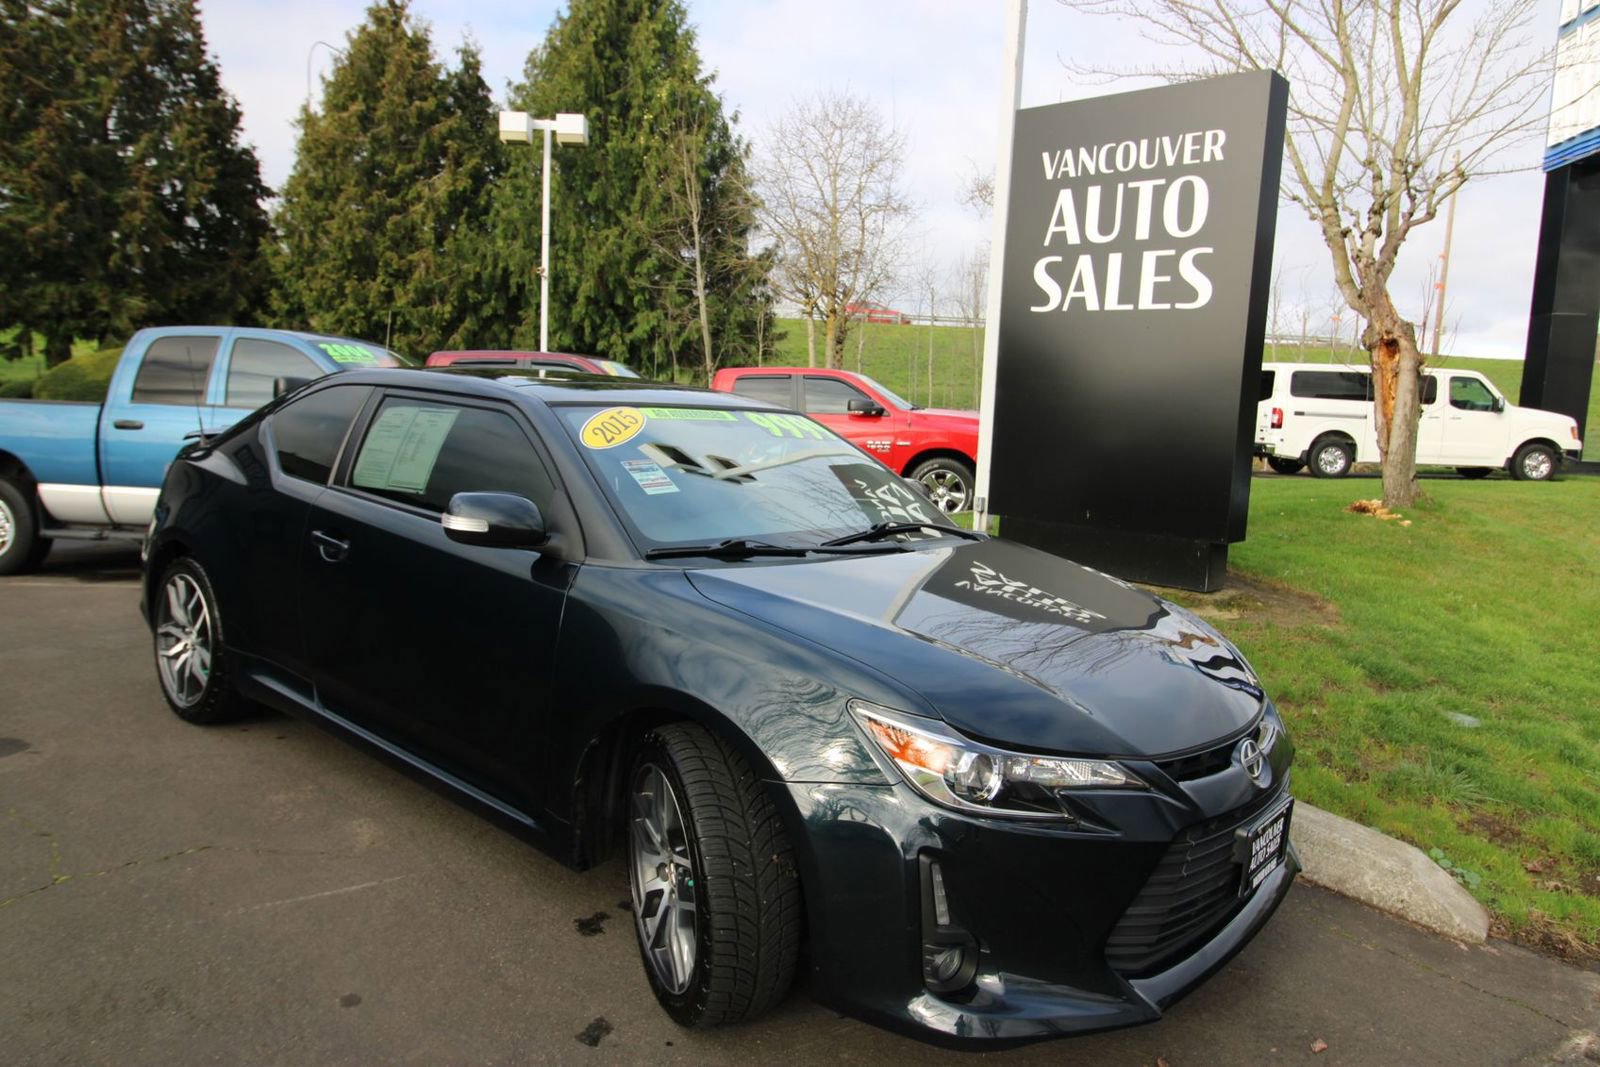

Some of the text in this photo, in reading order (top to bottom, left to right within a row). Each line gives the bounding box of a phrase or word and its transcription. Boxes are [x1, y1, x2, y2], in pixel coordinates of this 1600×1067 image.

[1042, 129, 1226, 180] VANCOUVER
[1043, 175, 1209, 246] AUTO
[1030, 247, 1214, 312] SALES
[592, 410, 639, 444] 2015
